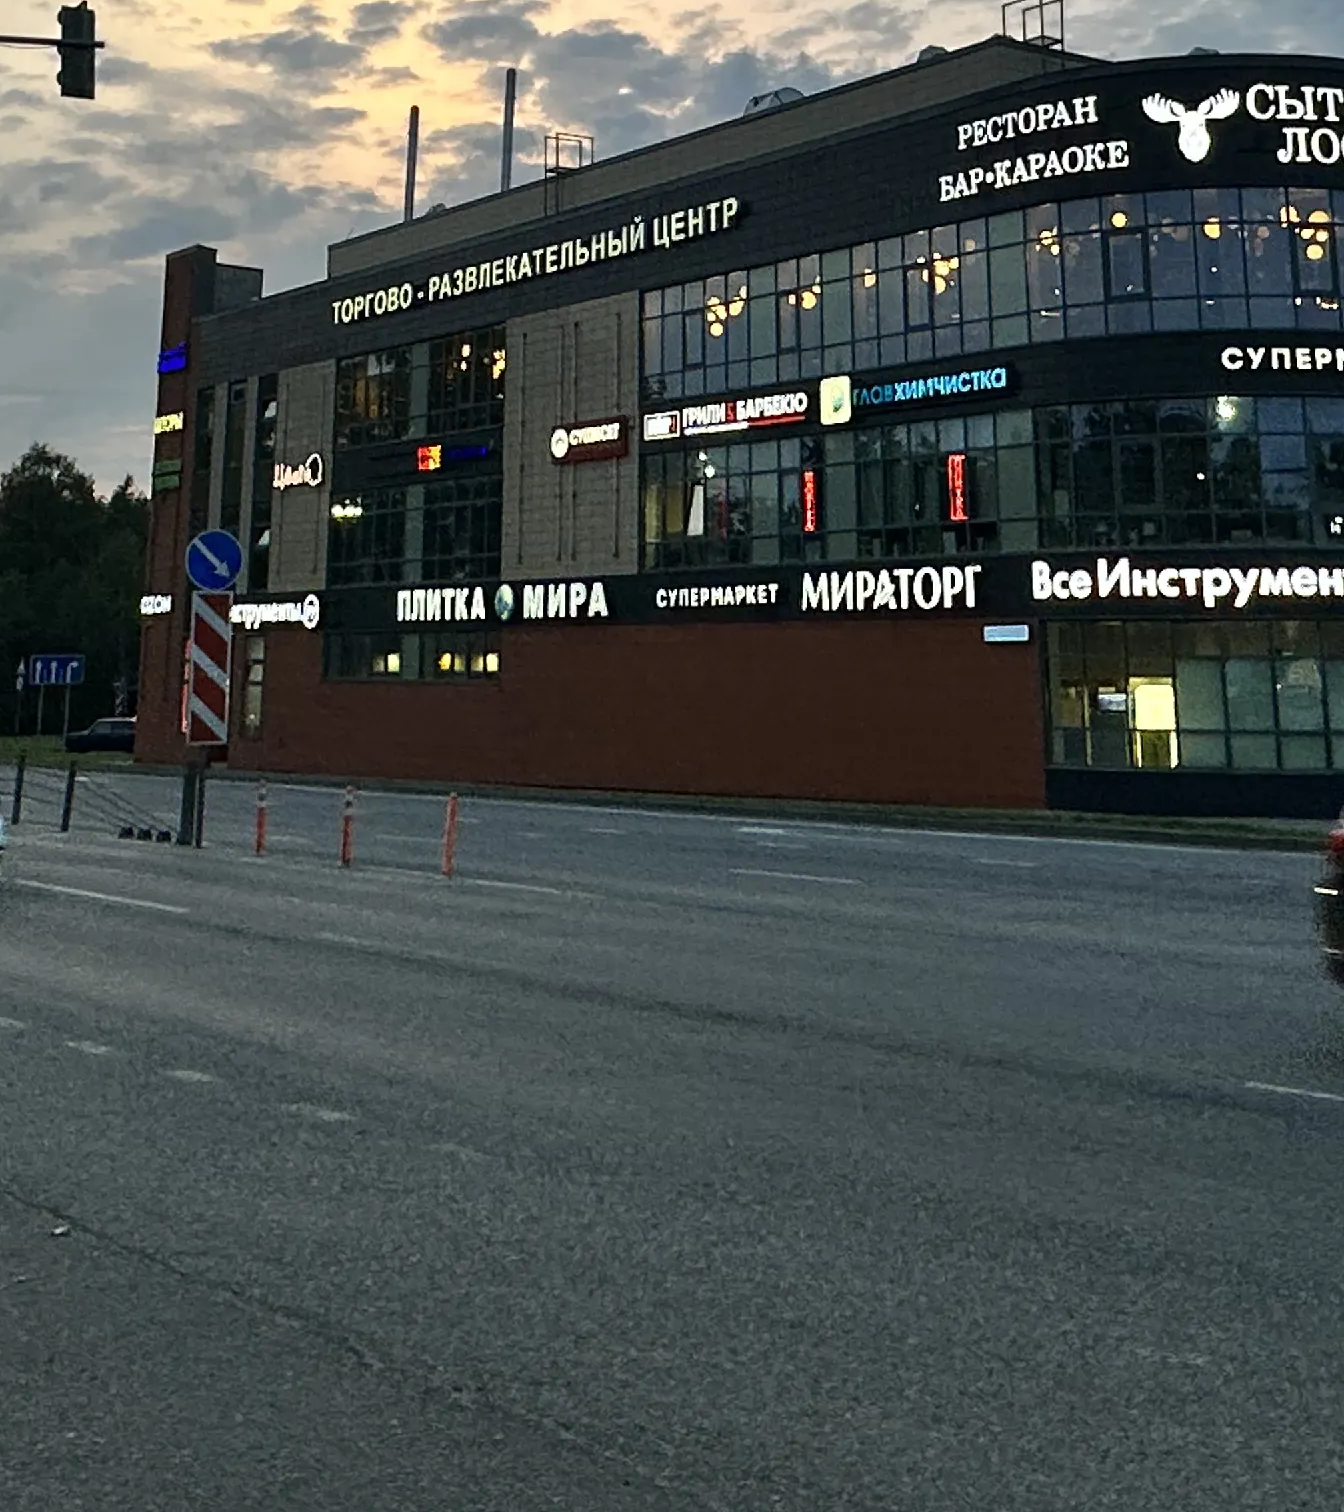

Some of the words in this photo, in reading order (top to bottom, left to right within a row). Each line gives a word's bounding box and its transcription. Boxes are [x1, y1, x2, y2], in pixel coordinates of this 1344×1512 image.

[958, 96, 1098, 150] РЕСТОРАН
[653, 197, 738, 248] ЦЕНТР
[396, 586, 486, 622] ПЛИТКА
[523, 582, 609, 620] МИРА
[656, 583, 779, 608] СУПЕРМАРКЕТ
[801, 564, 982, 611] МИРАТОРГ
